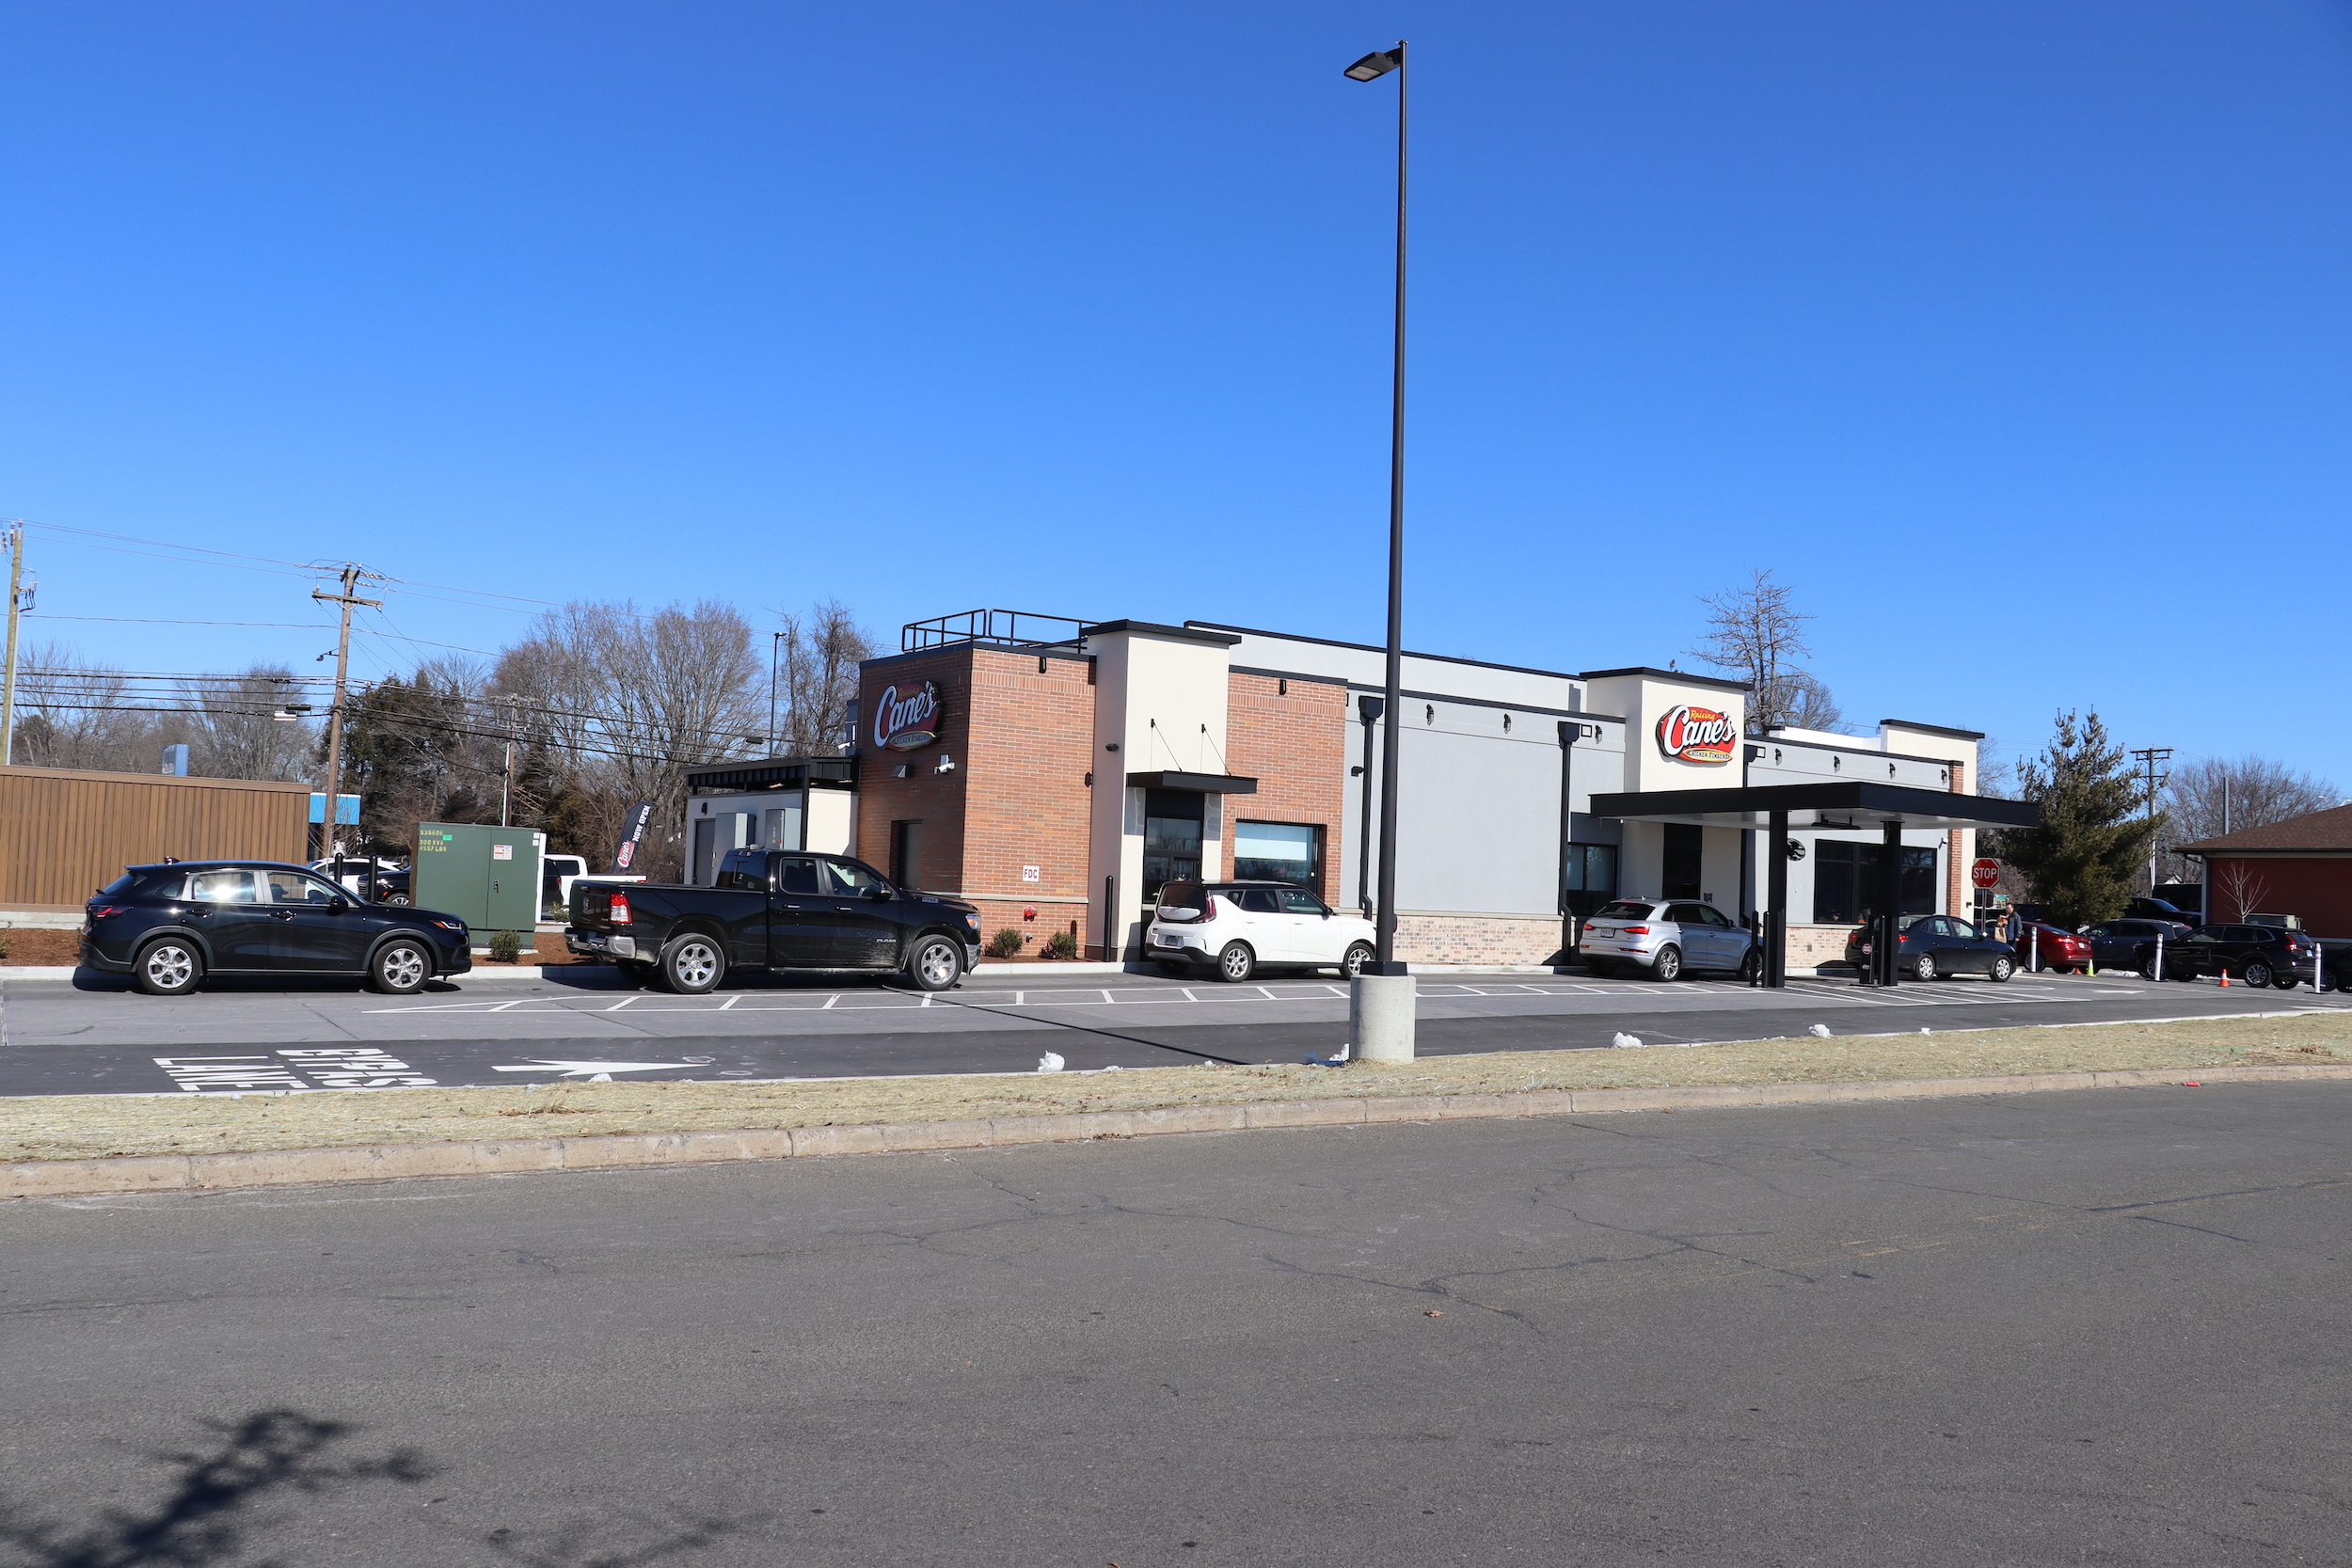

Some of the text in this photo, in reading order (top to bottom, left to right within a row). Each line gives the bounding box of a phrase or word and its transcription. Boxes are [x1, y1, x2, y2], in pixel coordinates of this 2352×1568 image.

[874, 680, 939, 748] Cane's
[1664, 705, 1737, 755] Cane's
[1690, 709, 1716, 721] Raising
[632, 804, 651, 843] NOW OPEN
[617, 841, 630, 868] Cane's
[1025, 868, 1038, 879] FDC
[1973, 867, 1997, 879] STOP
[152, 1055, 310, 1091] LANE
[276, 1048, 438, 1088] BYPAS
